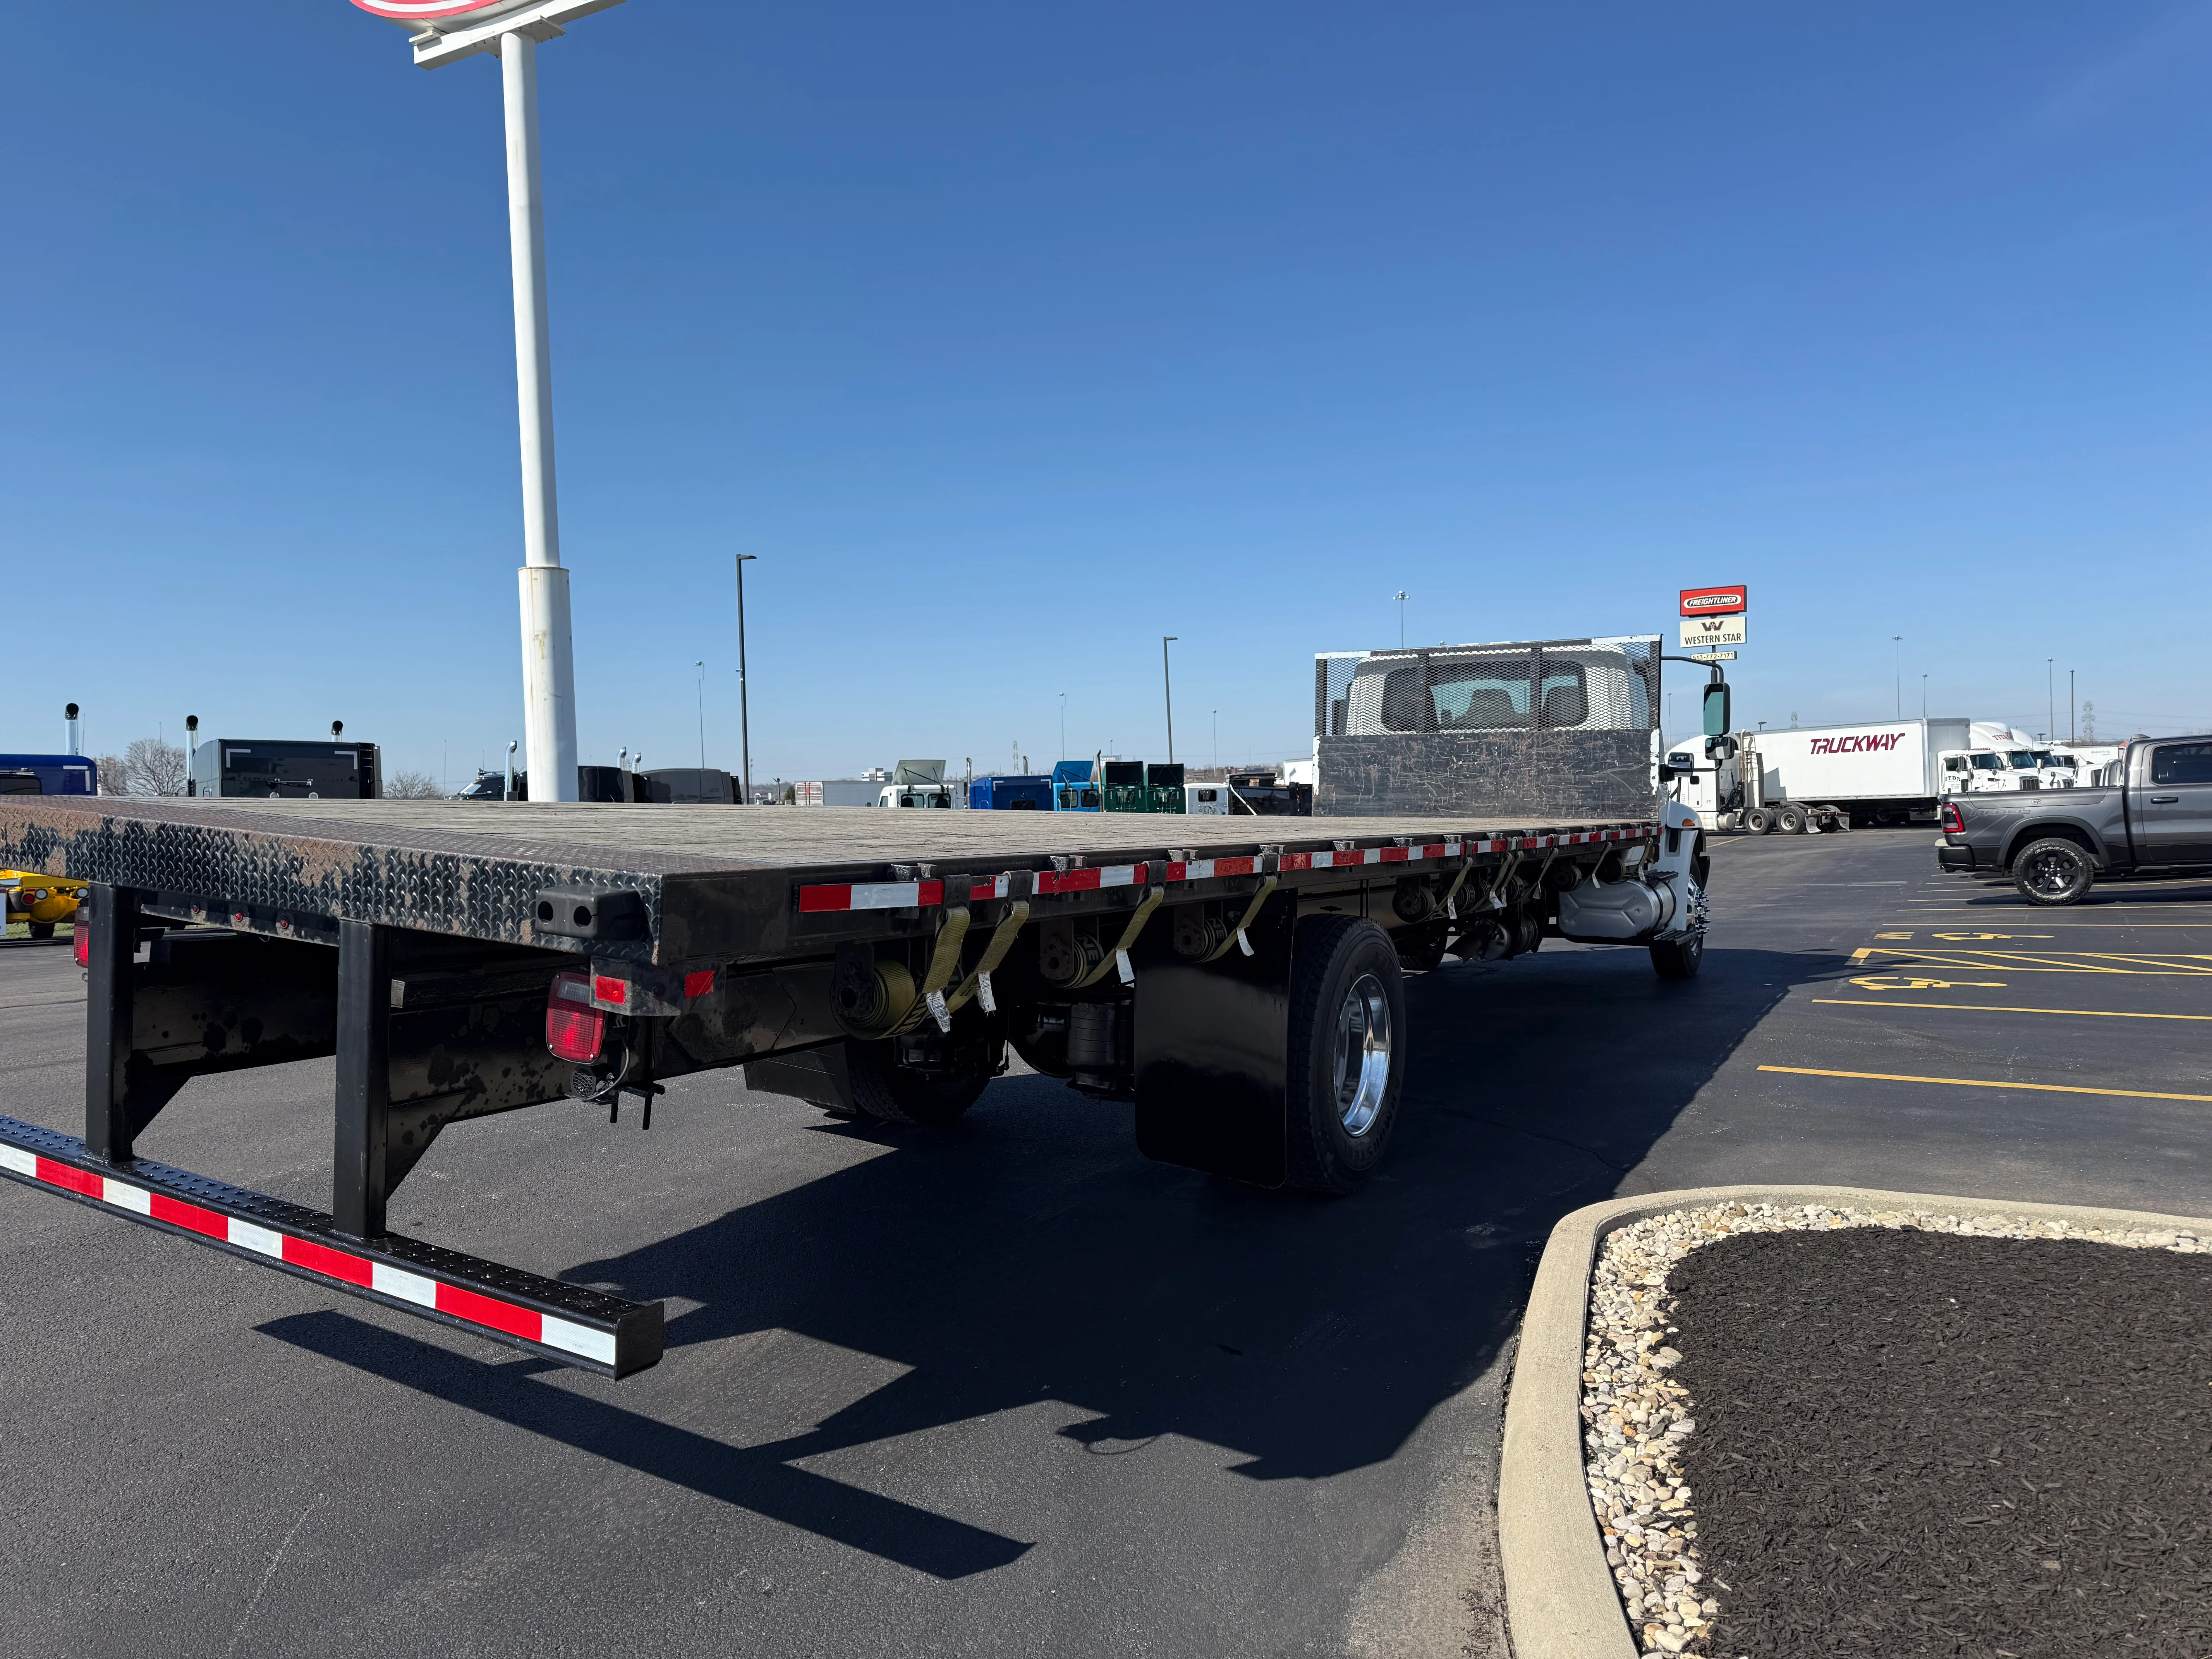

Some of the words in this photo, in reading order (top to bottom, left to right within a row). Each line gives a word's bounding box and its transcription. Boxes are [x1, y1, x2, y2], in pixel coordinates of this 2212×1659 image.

[1689, 596, 1736, 606] FREIGHTLINER
[1685, 634, 1720, 645] WESTERN
[1723, 633, 1741, 642] STAR
[1811, 733, 1905, 754] TRUCKWAY
[1969, 808, 2030, 817] REBEL
